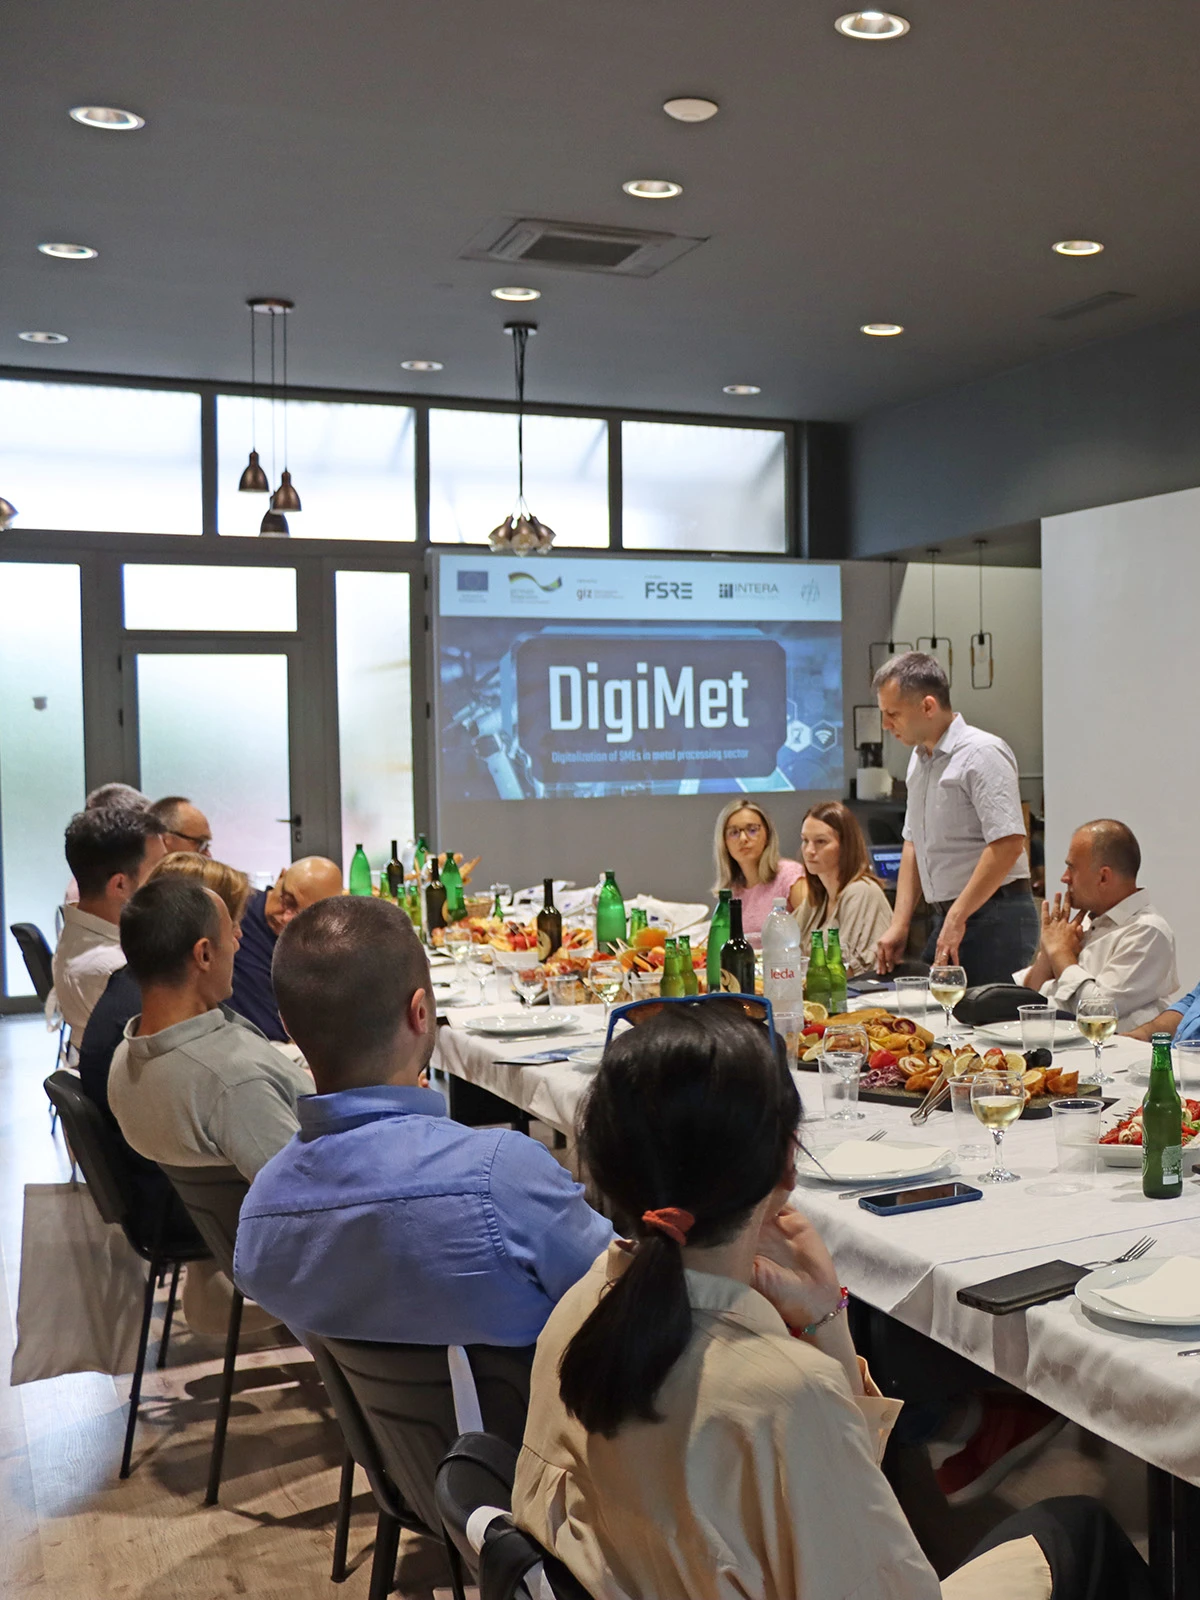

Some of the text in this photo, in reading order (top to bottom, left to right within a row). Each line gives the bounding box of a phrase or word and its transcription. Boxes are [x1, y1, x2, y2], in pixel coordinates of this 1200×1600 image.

[576, 588, 593, 602] giz
[645, 582, 693, 600] FSRE
[734, 583, 779, 594] INTERA
[548, 661, 750, 744] DigiMet
[609, 750, 618, 762] of
[619, 750, 641, 762] SMEs
[677, 749, 722, 762] processing
[723, 749, 750, 759] sector
[770, 968, 795, 980] leda
